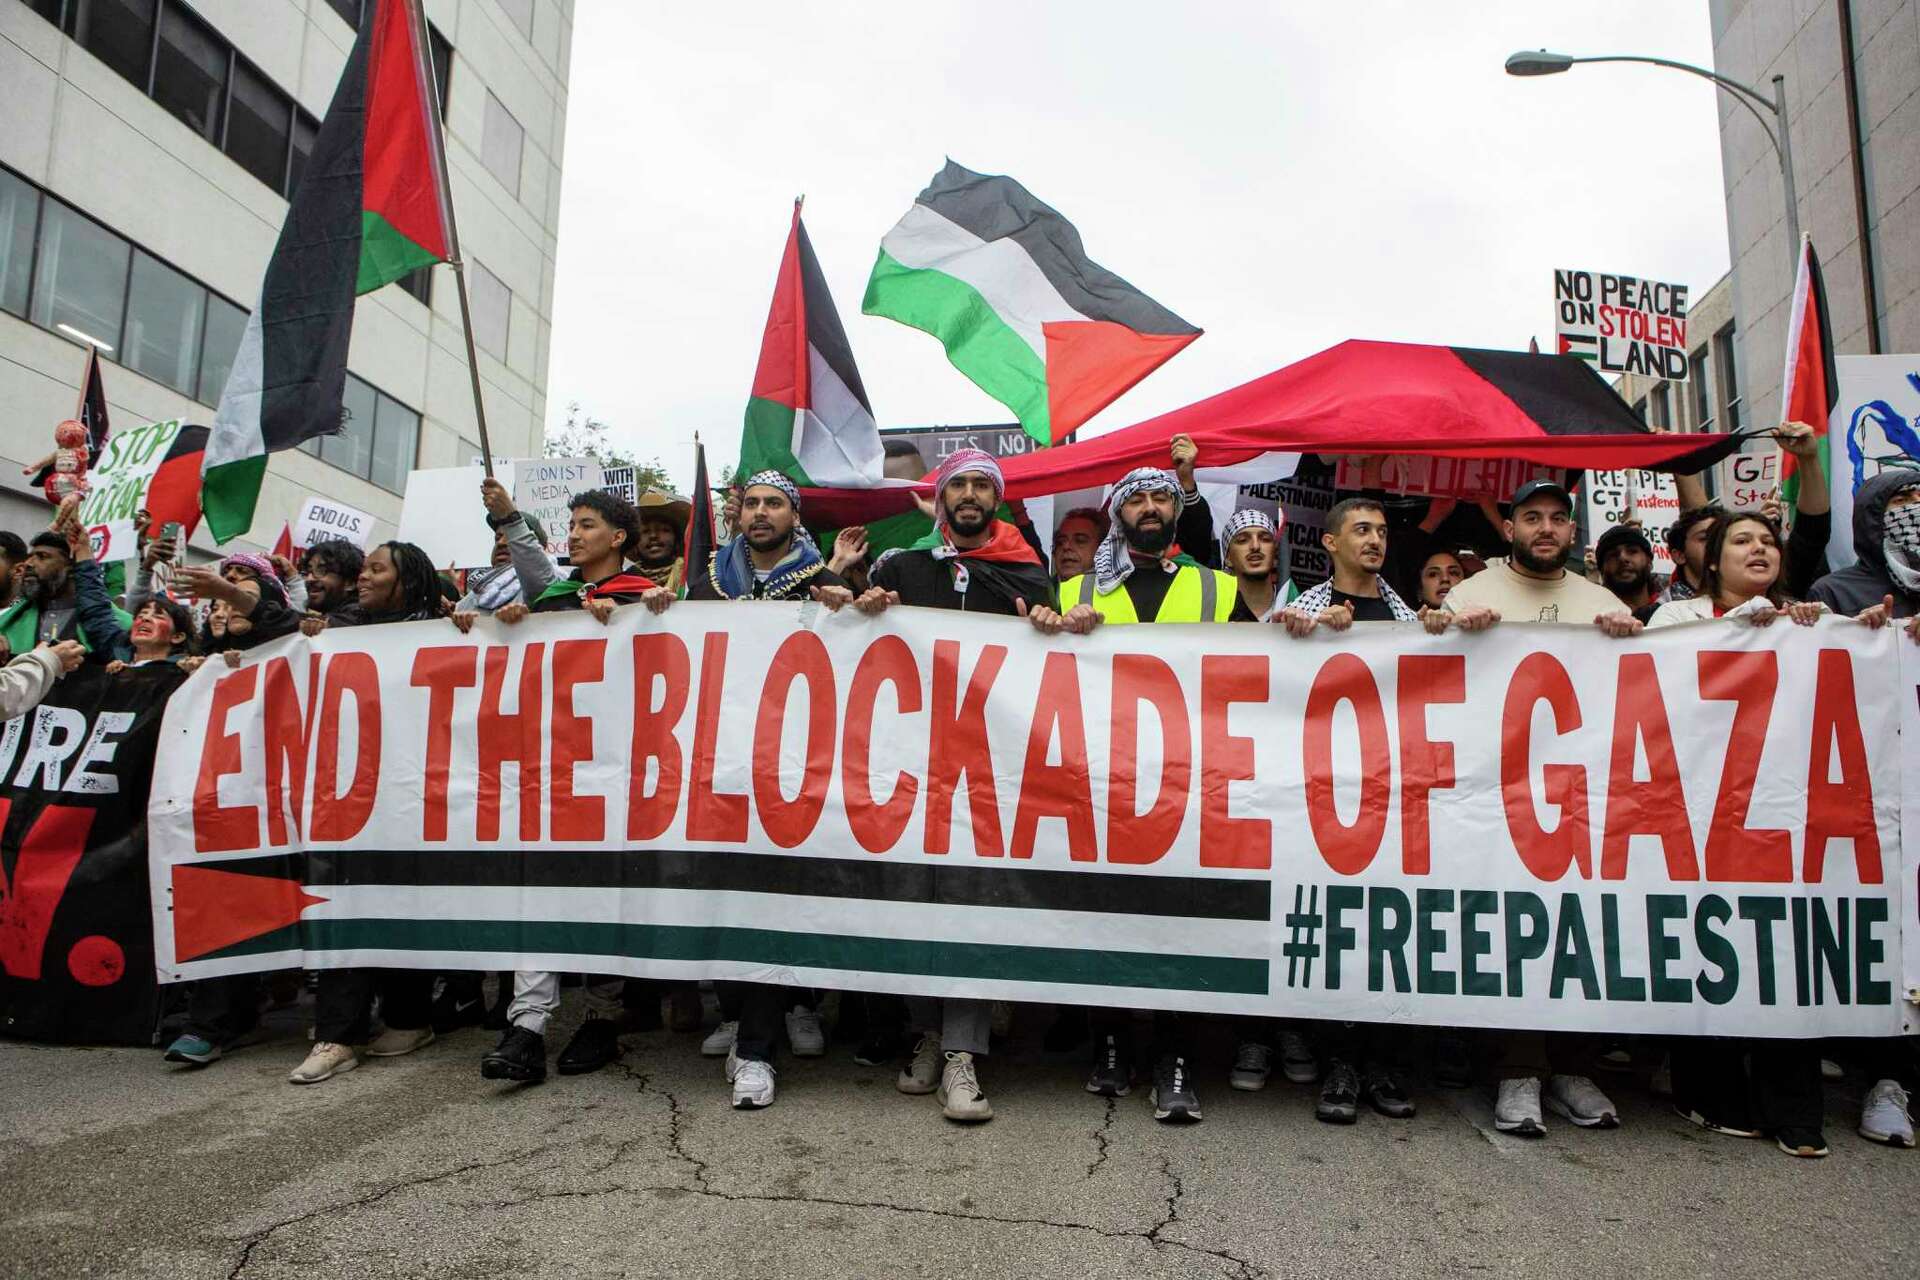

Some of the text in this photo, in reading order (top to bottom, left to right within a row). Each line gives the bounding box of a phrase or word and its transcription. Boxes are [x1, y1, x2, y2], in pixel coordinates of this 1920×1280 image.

[1555, 270, 1688, 319] NO PEACE
[1561, 301, 1686, 349] ON STOLEN
[1600, 337, 1687, 380] LAND
[98, 421, 178, 474] STOP
[525, 465, 587, 483] ZIONIST
[532, 485, 572, 501] MEDIA
[604, 467, 633, 486] WITH
[308, 505, 361, 534] END U.S.
[193, 652, 381, 852] END
[410, 638, 607, 842] THE
[627, 630, 1272, 870] BLOCKADE
[1302, 652, 1466, 876] OF
[1501, 649, 1883, 883] GAZA
[1283, 884, 1893, 1006] #FREEPALESTINE
